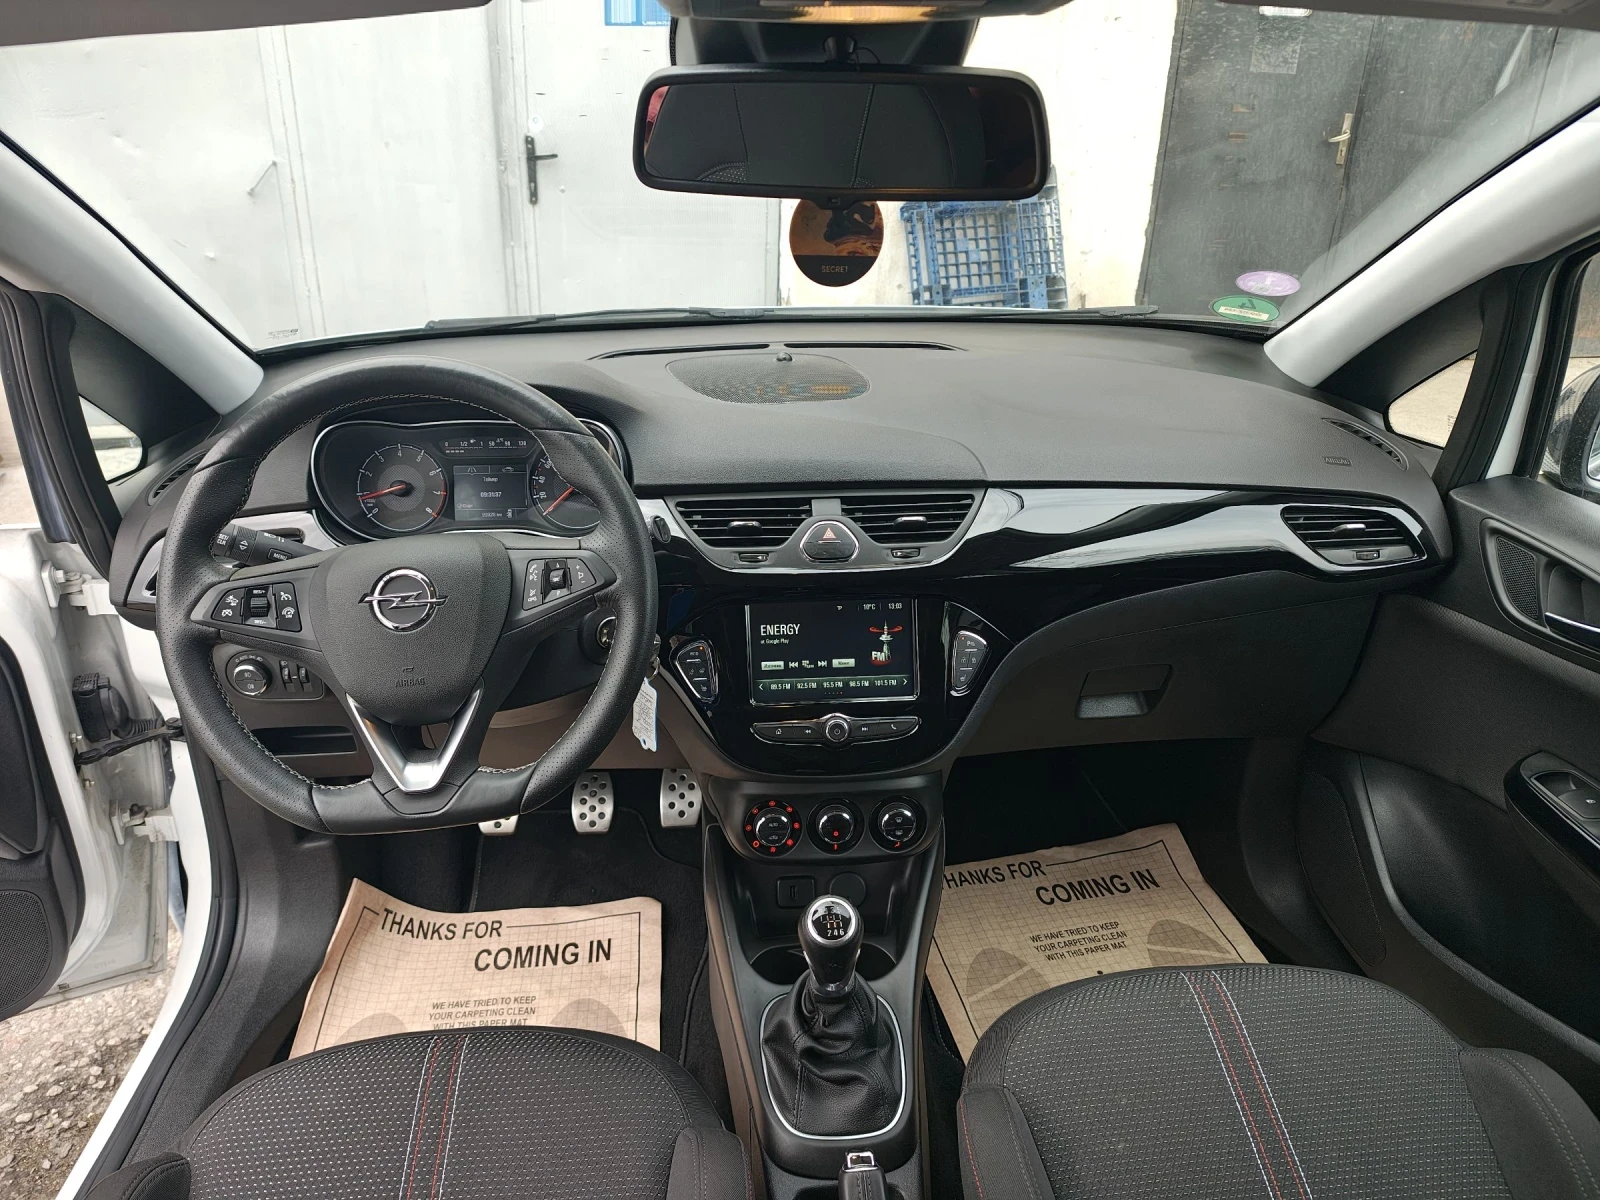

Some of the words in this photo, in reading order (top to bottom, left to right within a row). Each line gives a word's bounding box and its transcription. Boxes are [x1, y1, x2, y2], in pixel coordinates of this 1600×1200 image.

[760, 623, 801, 636] ENERGY
[871, 651, 885, 661] FM
[395, 677, 426, 688] AIRBAG
[942, 866, 1006, 890] HANKS
[1006, 860, 1047, 880] FOR
[1035, 874, 1131, 906] COMING
[1129, 868, 1160, 891] IN
[381, 907, 457, 941] THANKS
[462, 920, 503, 940] FOR
[1029, 934, 1044, 943] WE
[1043, 930, 1065, 941] HAVE
[1064, 926, 1088, 937] TRIED
[1087, 924, 1099, 933] TO
[1099, 921, 1120, 931] KEEP
[1034, 942, 1057, 953] YOUR
[1057, 935, 1101, 949] CARPETING
[1101, 930, 1128, 942] CLEAN
[1045, 951, 1067, 961] WITH
[1066, 948, 1085, 958] THIS
[1084, 943, 1111, 955] PAPER
[1110, 940, 1128, 950] MAT
[474, 942, 580, 972] COMING
[587, 937, 612, 964] IN
[432, 1001, 446, 1010] WE
[447, 1000, 471, 1009] HAVE
[473, 997, 498, 1007] TRIED
[500, 996, 512, 1005] TO
[513, 995, 537, 1005] KEEP
[429, 1011, 453, 1021] YOUR
[454, 1007, 505, 1019] CARPETING
[506, 1006, 536, 1016] CLEAN
[433, 1021, 455, 1031] WITH
[457, 1020, 477, 1029] THIS
[479, 1018, 508, 1027] PAPER
[509, 1018, 528, 1027] MAT
